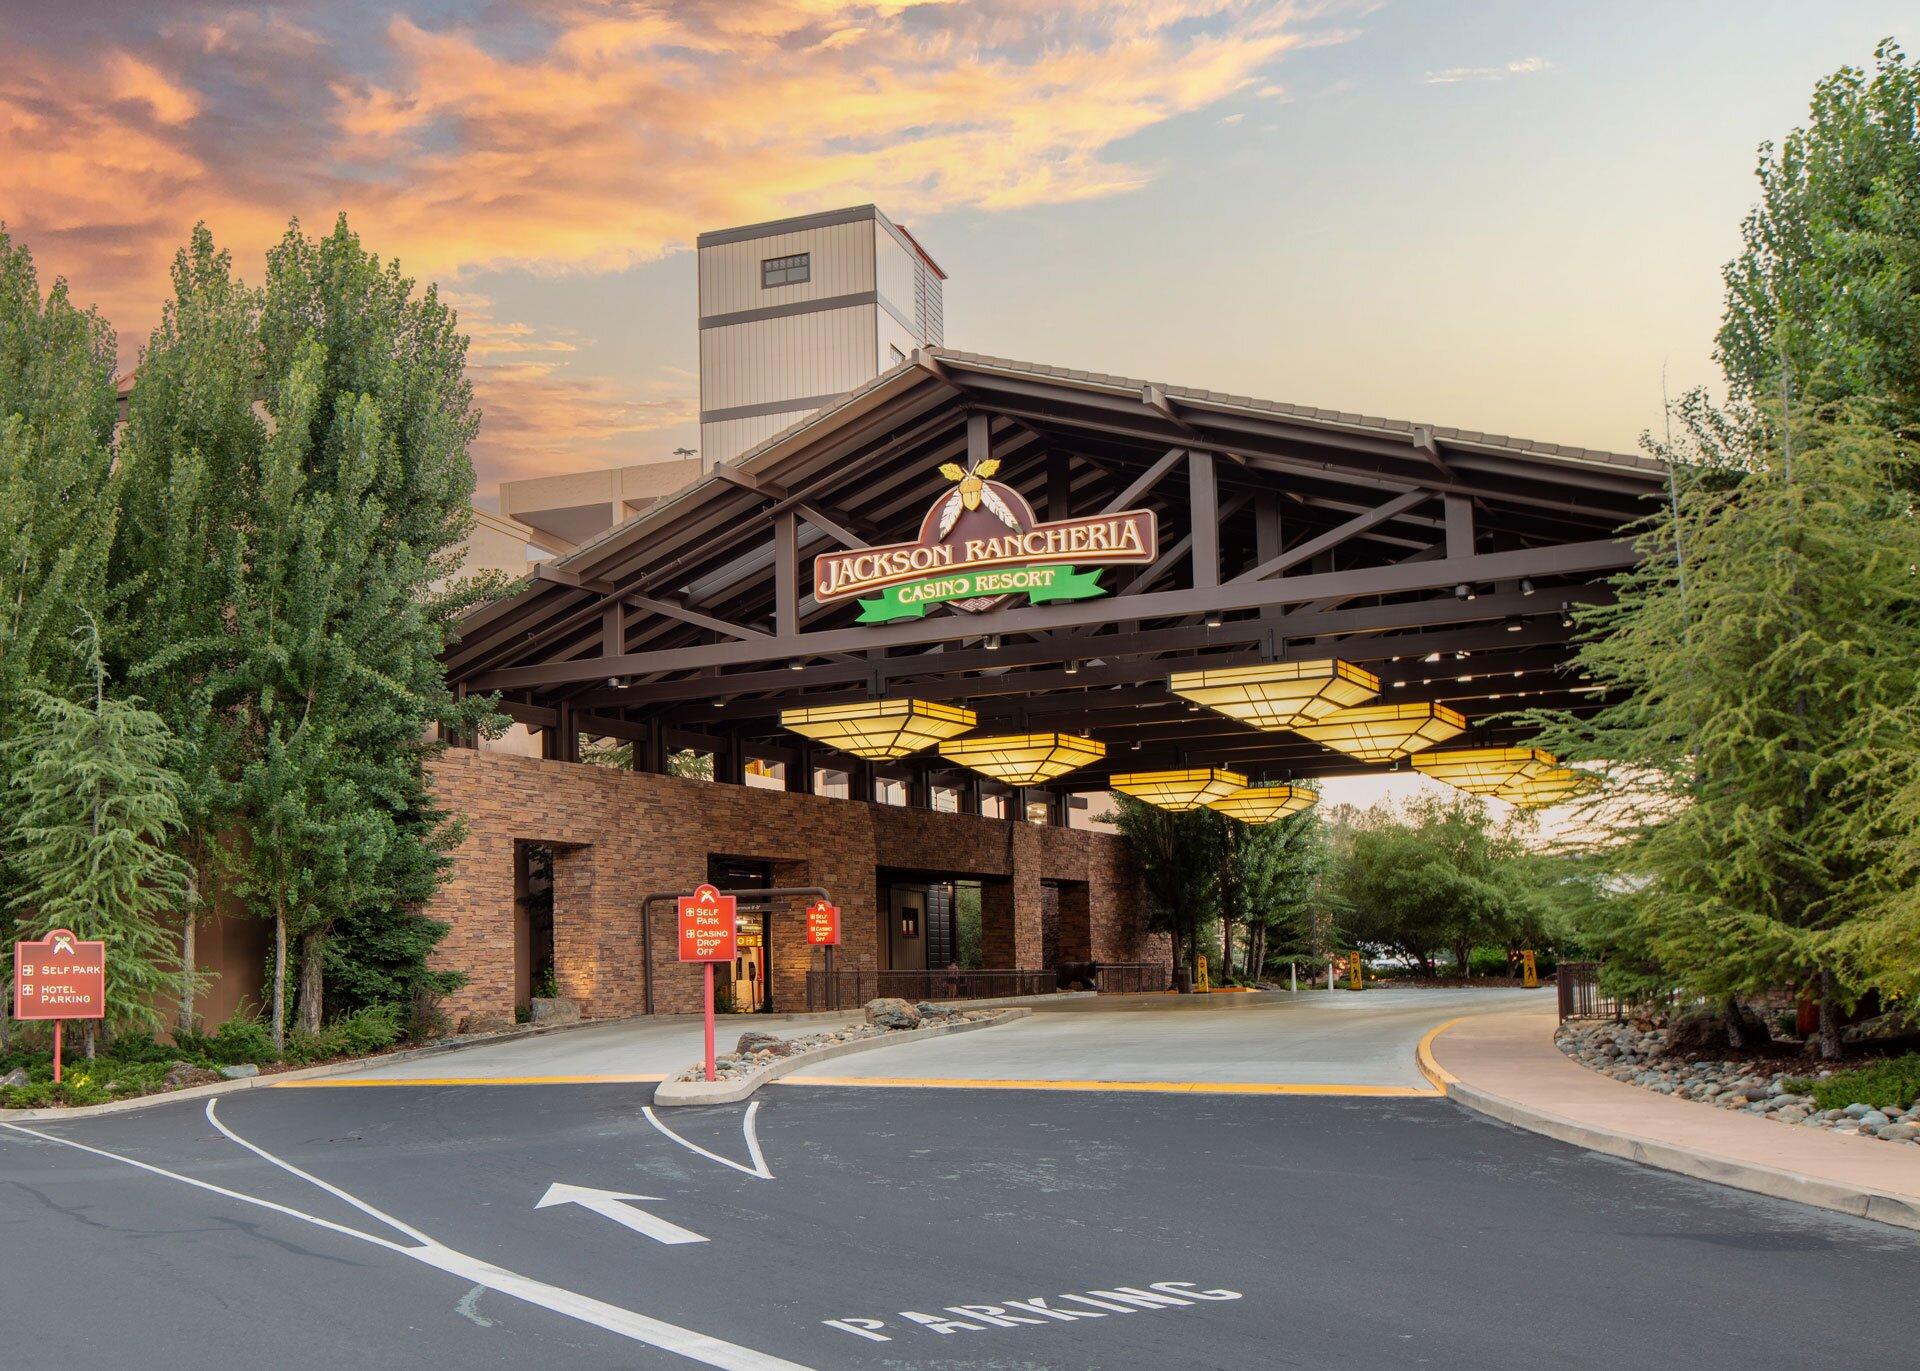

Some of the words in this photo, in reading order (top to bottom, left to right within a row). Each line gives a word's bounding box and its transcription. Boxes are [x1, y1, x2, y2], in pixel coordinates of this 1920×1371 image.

[819, 543, 953, 594] JACKSON
[965, 519, 1147, 561] RANCHERIA
[898, 578, 970, 604] CASINO
[975, 569, 1056, 593] RESORT
[696, 907, 720, 916] SELF
[696, 917, 720, 925] PARK
[696, 929, 729, 938] CASINO
[696, 938, 721, 947] DROP
[696, 947, 715, 956] OFF
[42, 965, 70, 975] SELF
[72, 965, 101, 975] PARK
[41, 985, 77, 994] HOTEL
[41, 995, 91, 1004] PARKING
[821, 1281, 1243, 1342] PARKING
